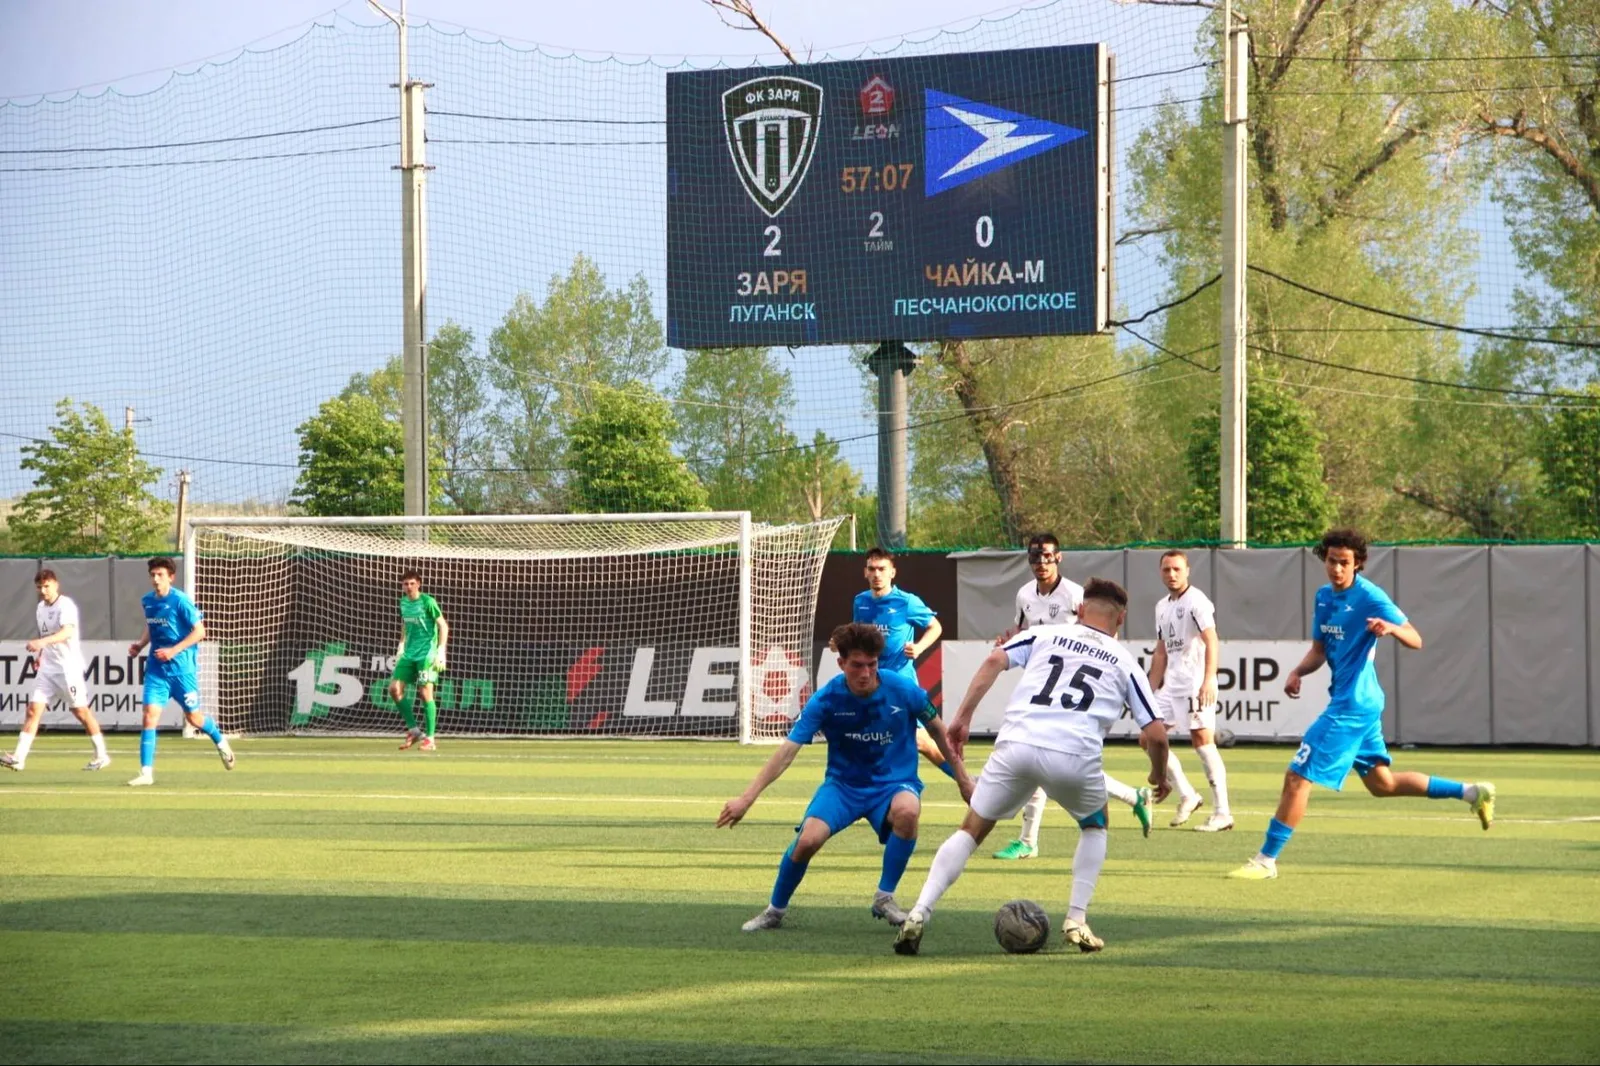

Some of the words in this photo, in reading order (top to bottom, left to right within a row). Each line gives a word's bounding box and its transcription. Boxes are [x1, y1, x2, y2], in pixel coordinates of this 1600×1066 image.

[745, 89, 765, 104] ФК
[767, 88, 800, 103] ЗАРЯ
[841, 163, 914, 193] 57:07
[868, 211, 885, 237] 2
[975, 215, 994, 248] 0
[763, 225, 782, 257] 2
[863, 239, 894, 252] ТАЙМ
[737, 269, 807, 296] ЗАРЯ
[925, 258, 1045, 287] ЧАЙКА-М
[729, 302, 816, 323] ЛУГАНСК
[894, 291, 1077, 316] ПЕСЧАНОКОПСКОЕ
[370, 656, 396, 672] ле
[1051, 635, 1119, 665] ТИТАРЕНКО
[0, 655, 148, 685] ТАМЫ
[287, 655, 364, 714] 15
[1030, 654, 1103, 712] 15
